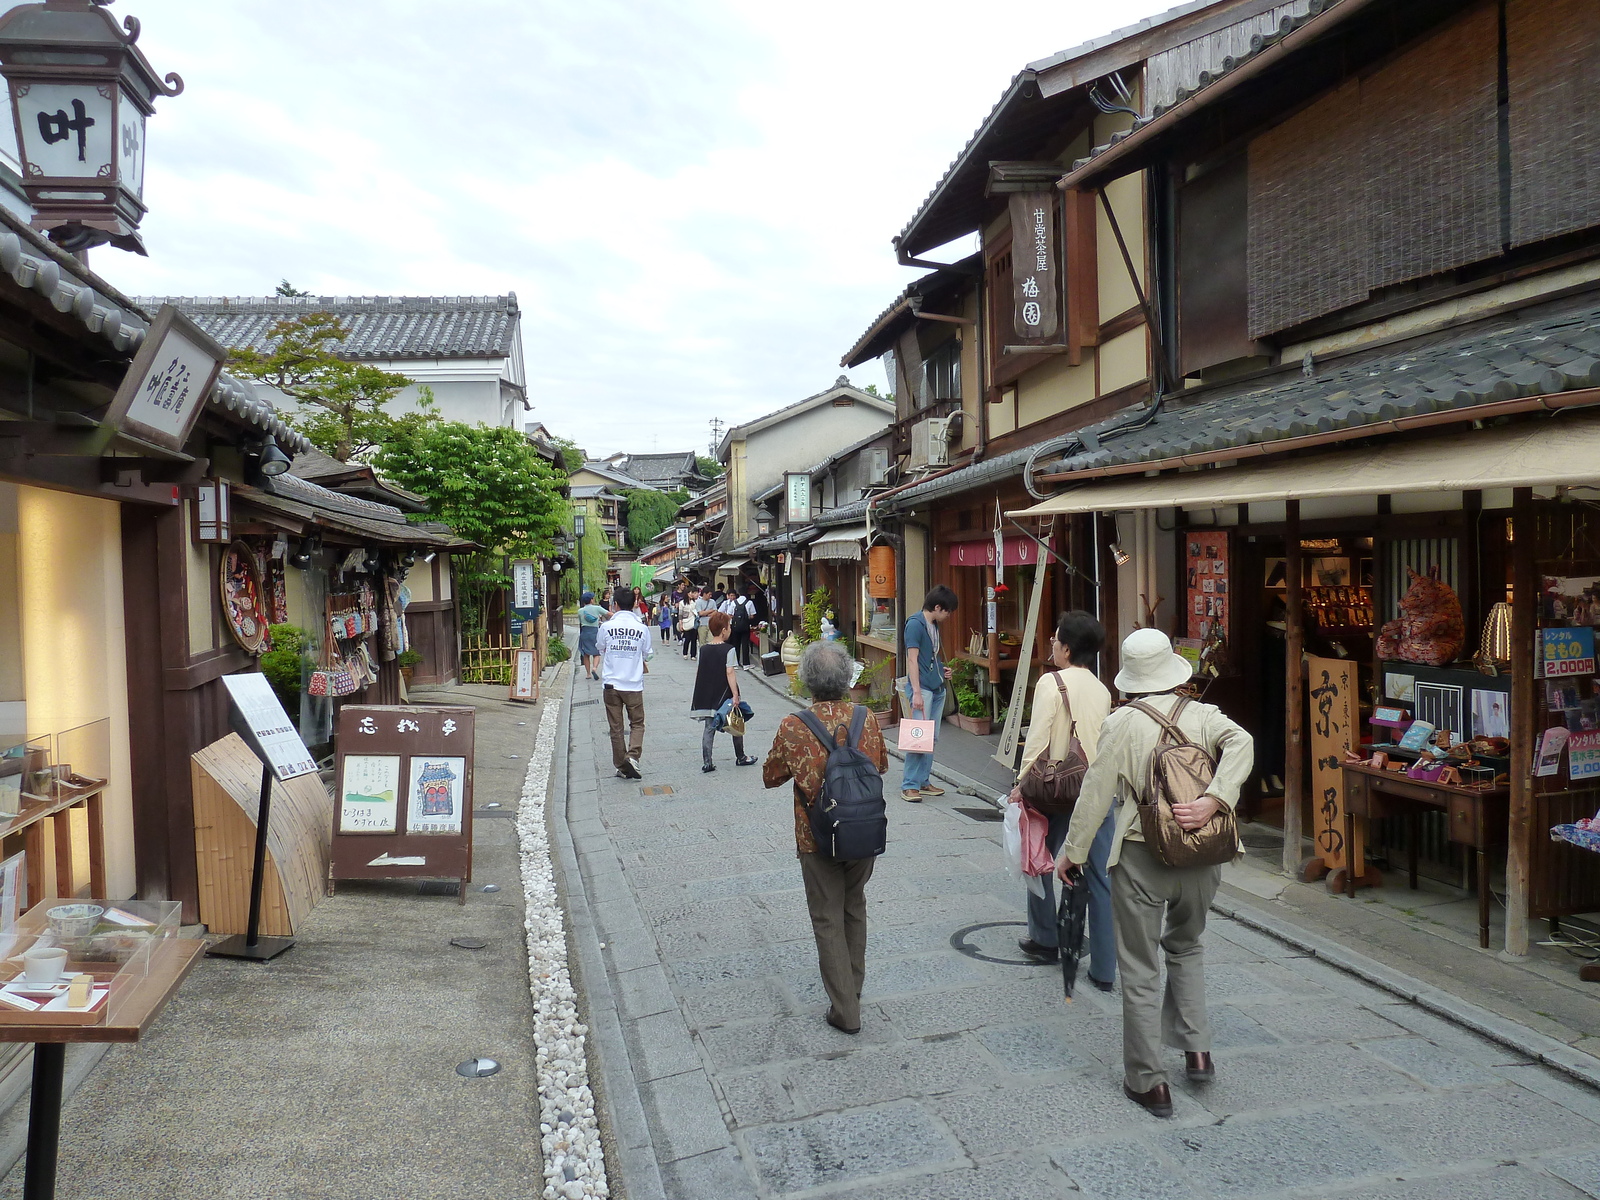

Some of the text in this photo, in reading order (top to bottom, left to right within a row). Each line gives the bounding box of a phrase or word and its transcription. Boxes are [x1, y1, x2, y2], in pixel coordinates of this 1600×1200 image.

[37, 98, 95, 163] 叶
[1034, 208, 1048, 271] 甘党茶屋
[607, 628, 643, 638] VISION
[1545, 632, 1572, 640] レンタル
[1545, 642, 1582, 659] きもの
[1546, 659, 1593, 675] 2,000円
